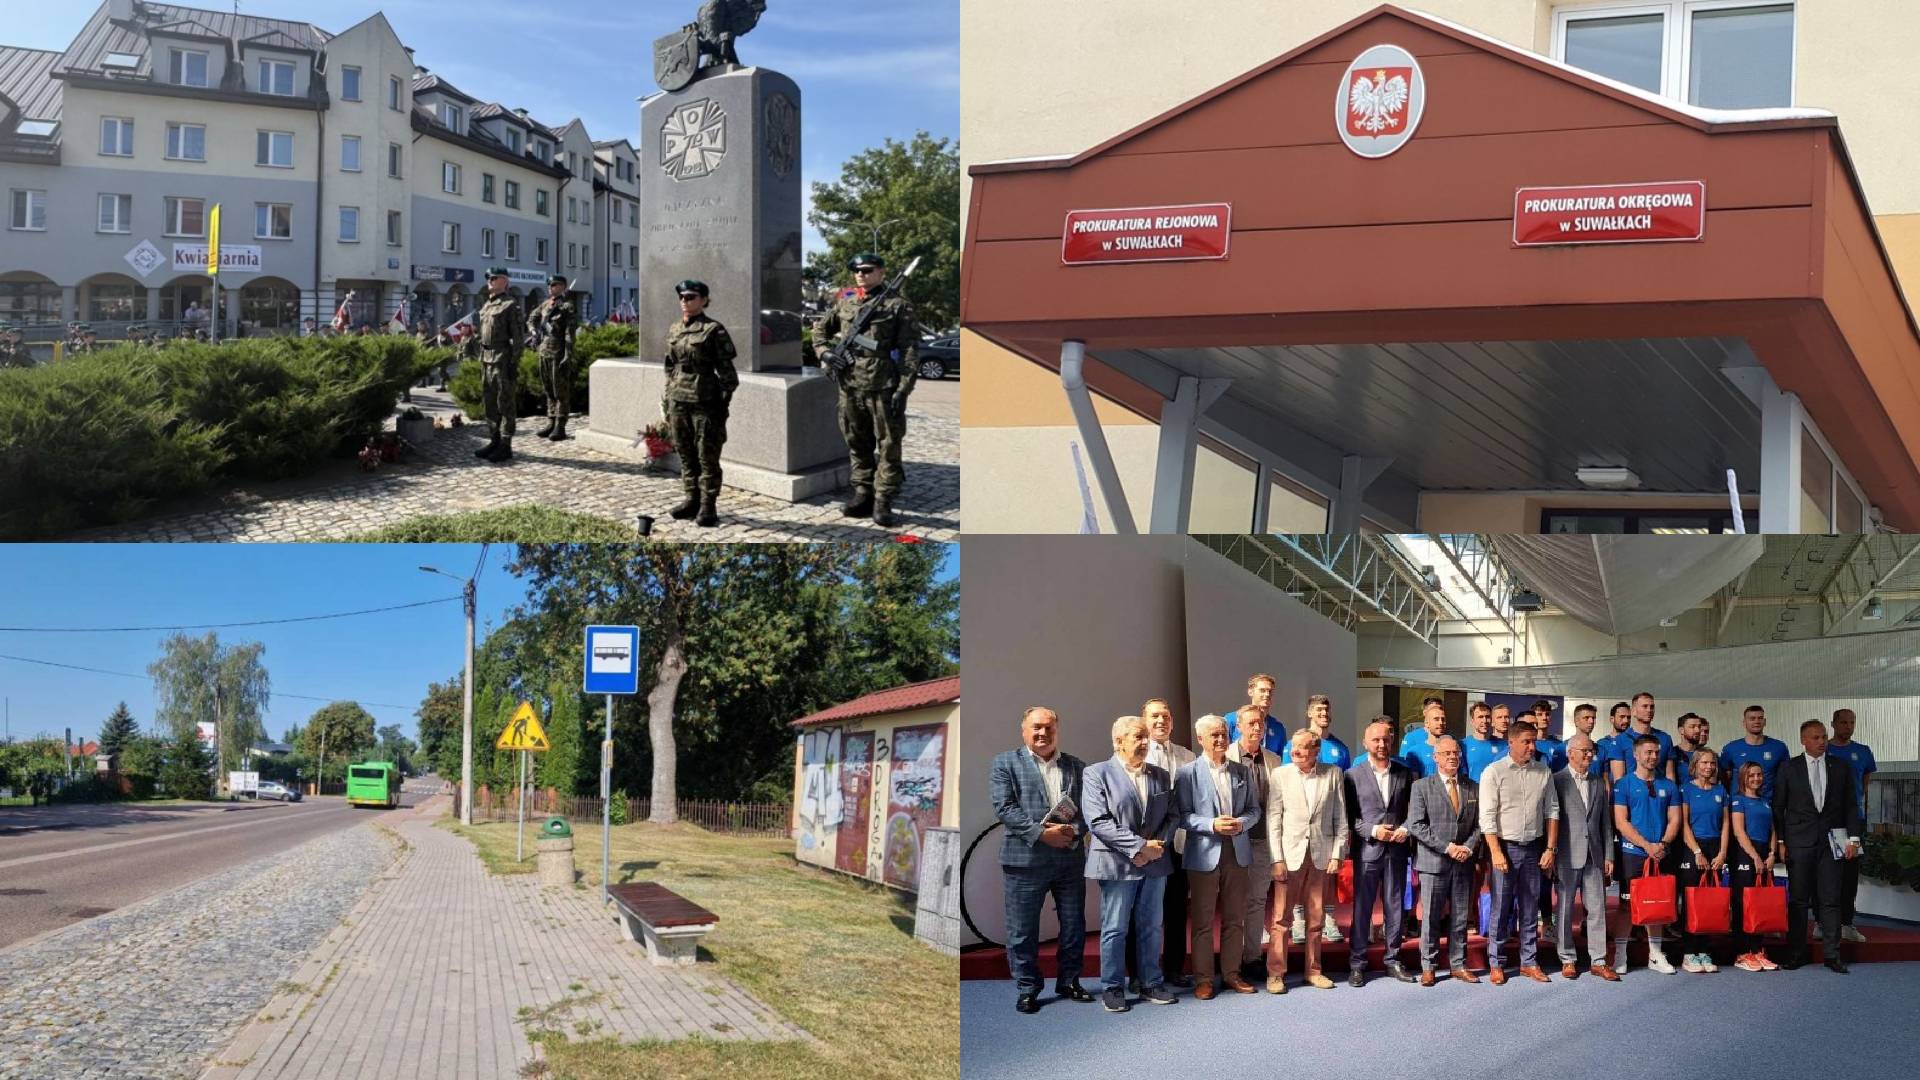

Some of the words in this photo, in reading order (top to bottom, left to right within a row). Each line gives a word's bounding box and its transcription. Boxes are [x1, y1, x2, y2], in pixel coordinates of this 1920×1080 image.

[1524, 196, 1615, 213] PROKURATURA
[1618, 193, 1694, 211] OKRĘGOWA
[1072, 216, 1152, 234] PROKURATURA
[1154, 214, 1218, 230] REJONOWA
[1559, 221, 1571, 232] w
[1574, 215, 1651, 232] SUWAŁKACH
[1102, 240, 1112, 251] w
[1115, 234, 1183, 250] SUWAŁKACH
[175, 249, 259, 266] Kwiaiarnia
